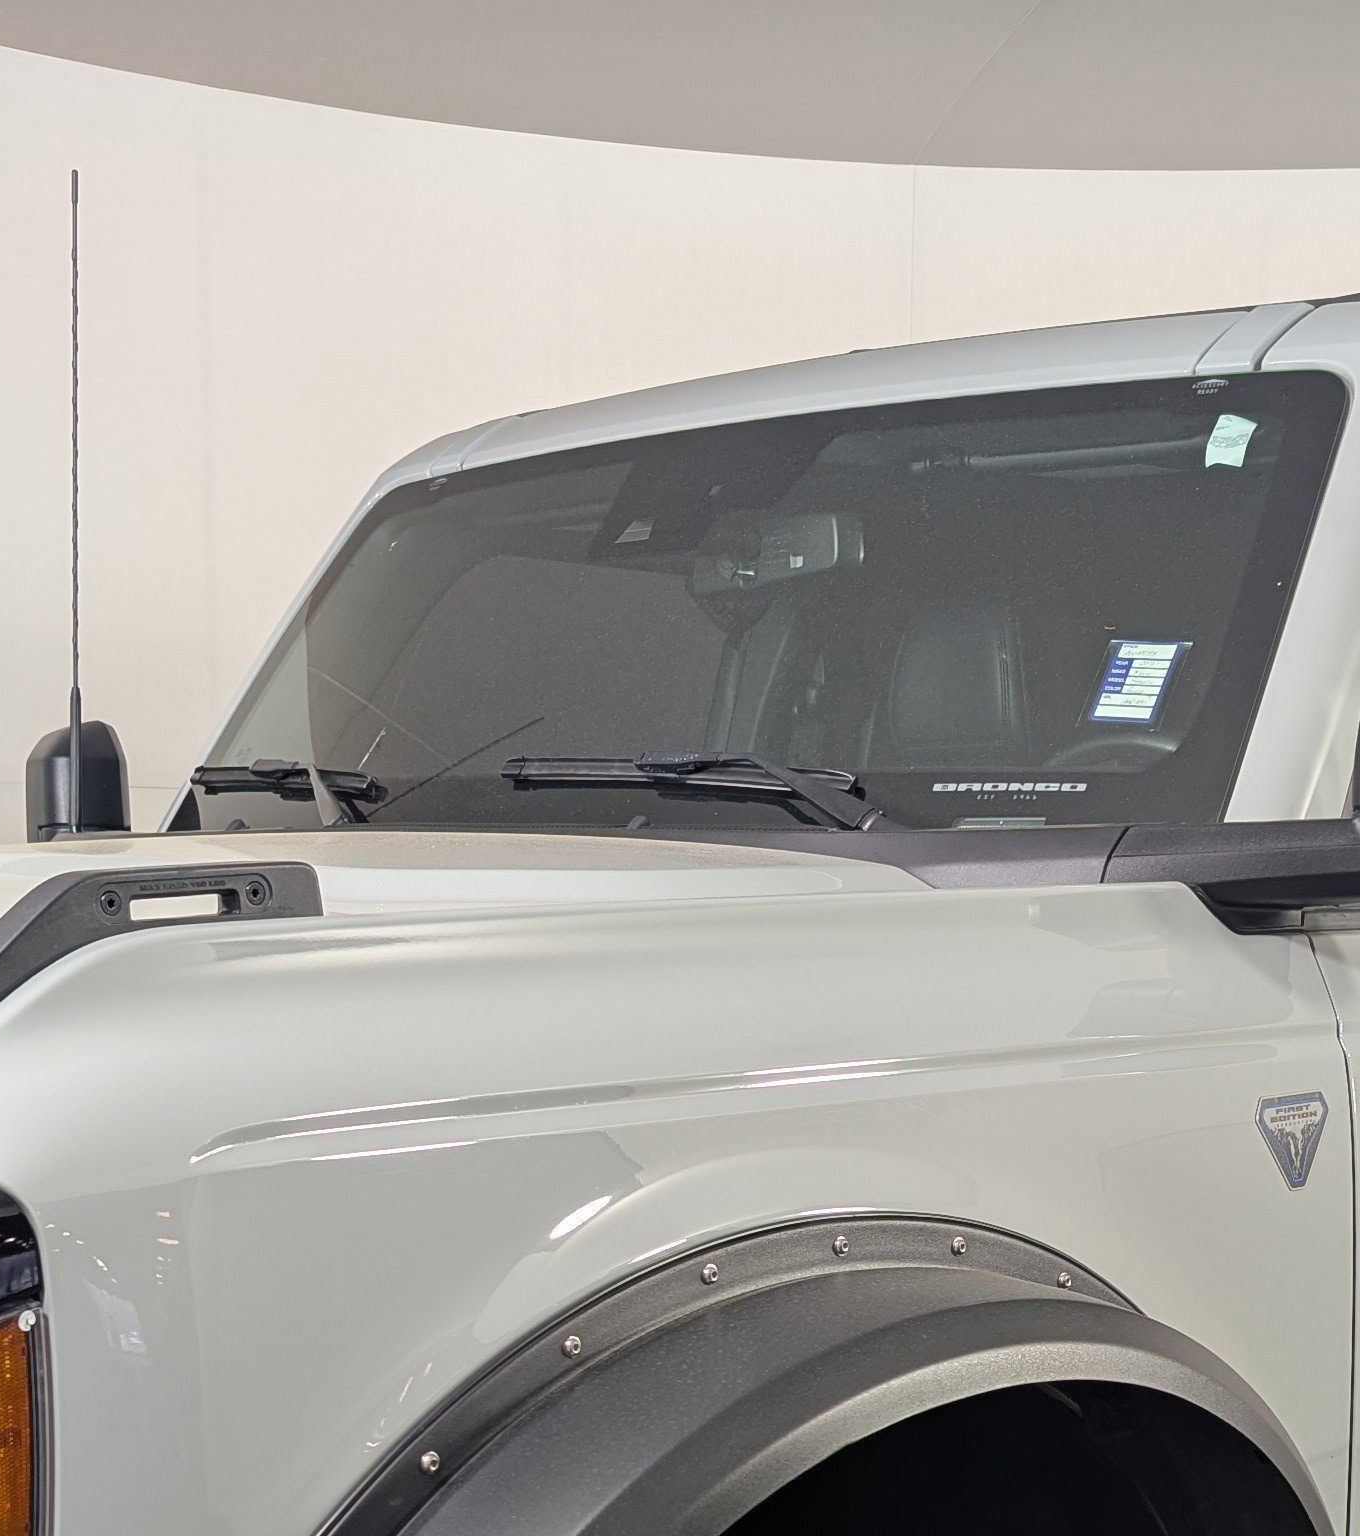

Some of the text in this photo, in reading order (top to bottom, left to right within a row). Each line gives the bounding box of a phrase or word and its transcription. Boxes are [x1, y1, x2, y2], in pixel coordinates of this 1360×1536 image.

[932, 783, 1088, 792] BRONCO
[1275, 1104, 1311, 1115] FIRST
[1270, 1110, 1318, 1124] EDITION
